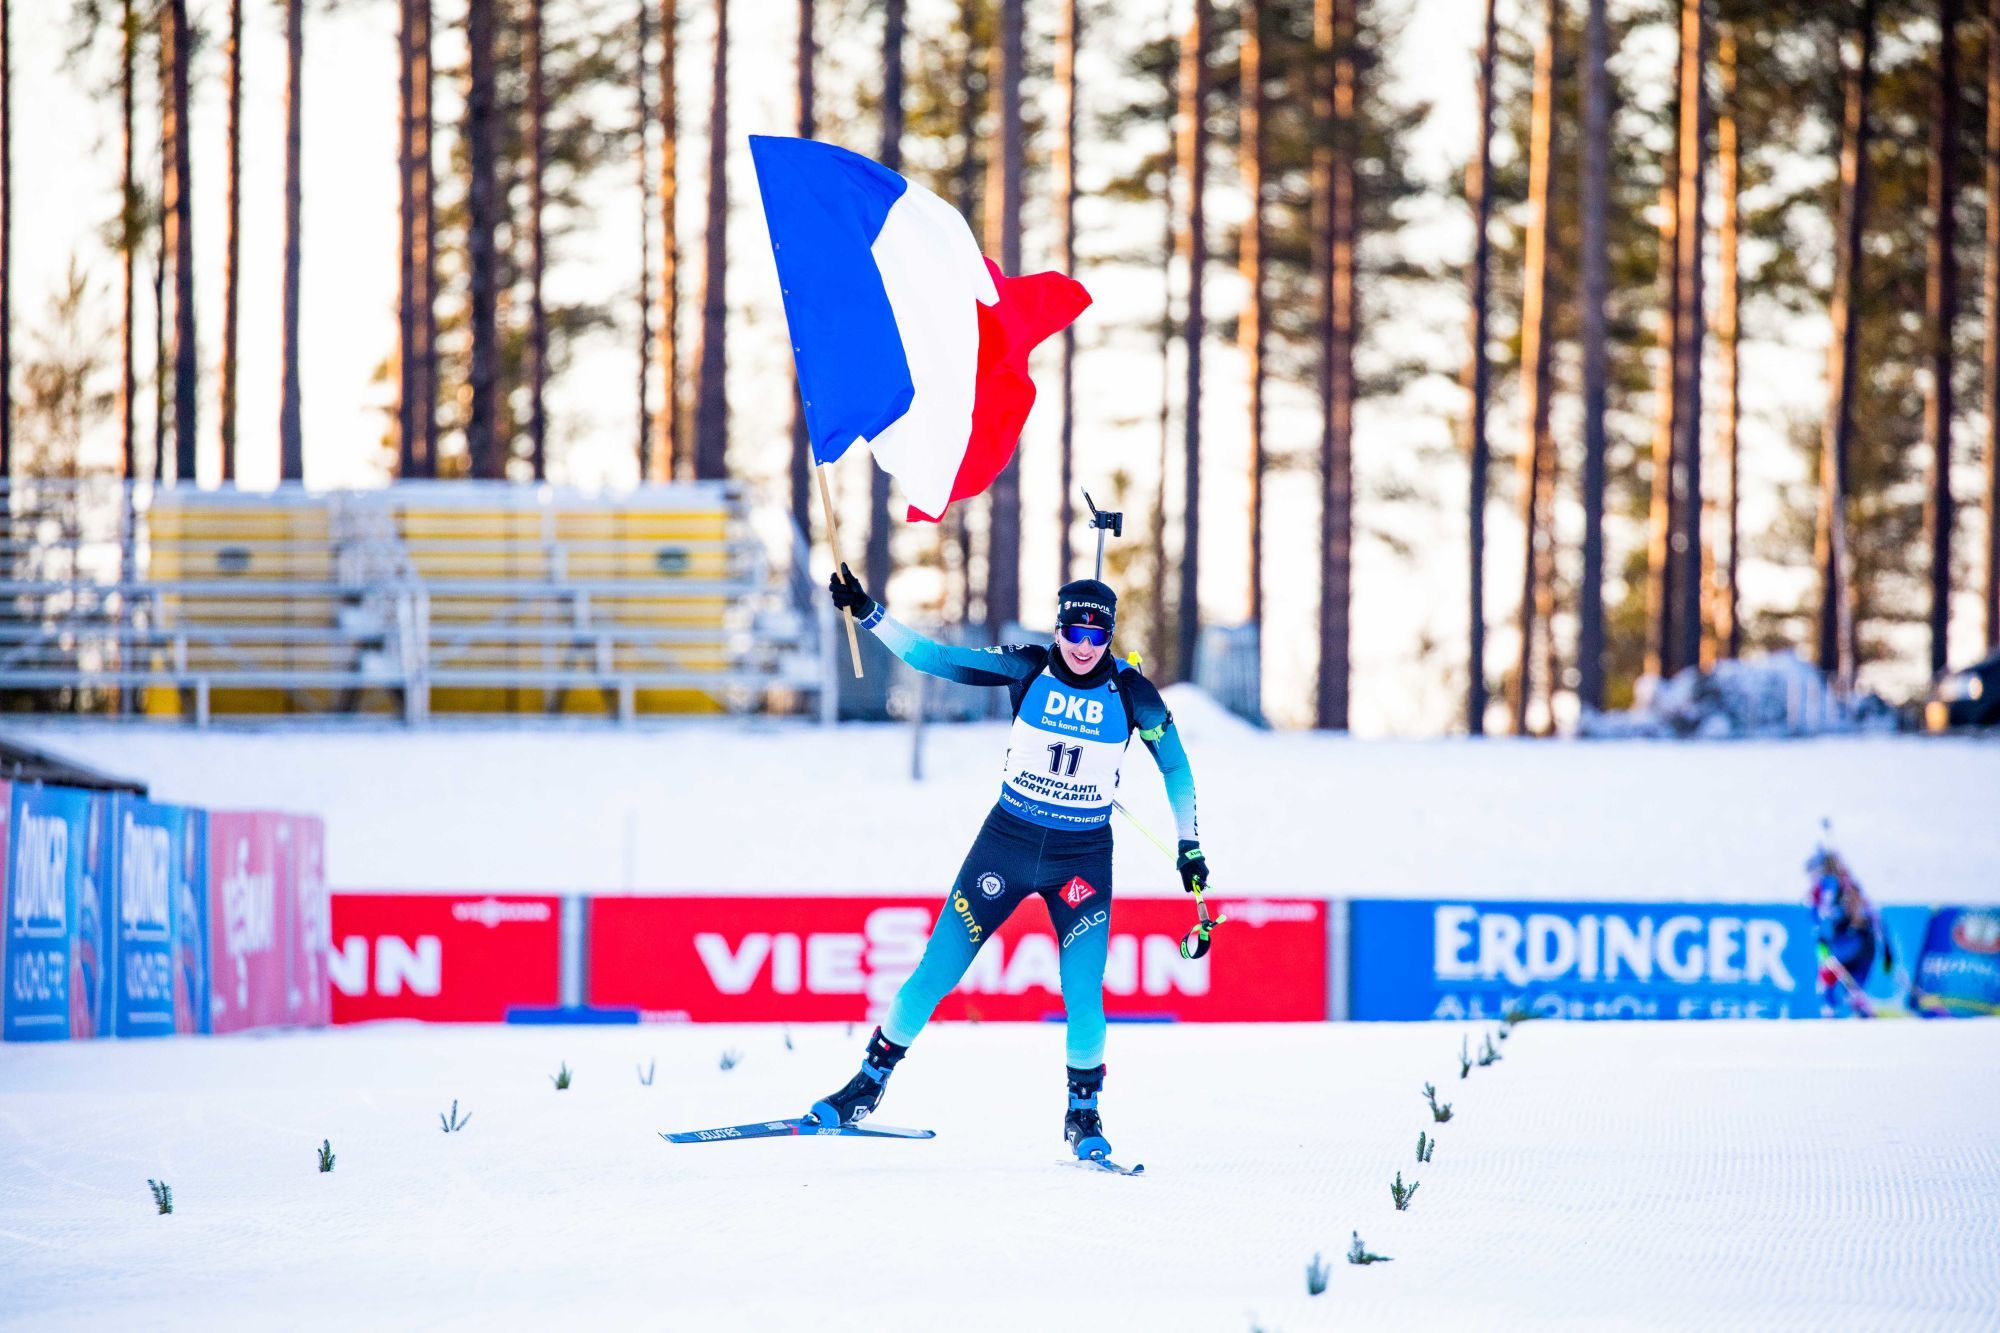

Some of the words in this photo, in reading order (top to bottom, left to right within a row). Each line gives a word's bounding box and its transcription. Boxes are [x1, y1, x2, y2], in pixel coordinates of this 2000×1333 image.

[1072, 602, 1110, 612] EUROVIA
[1044, 690, 1104, 724] DKB
[1041, 716, 1057, 727] Das
[1058, 720, 1078, 732] kann
[1080, 724, 1100, 736] Bank
[1047, 742, 1083, 777] 11
[1013, 776, 1051, 796] NORTH
[1020, 770, 1097, 793] KONTIOLAHTI
[953, 890, 982, 942] somfy
[1063, 911, 1107, 948] odlo
[1434, 905, 1795, 992] ERDINGER
